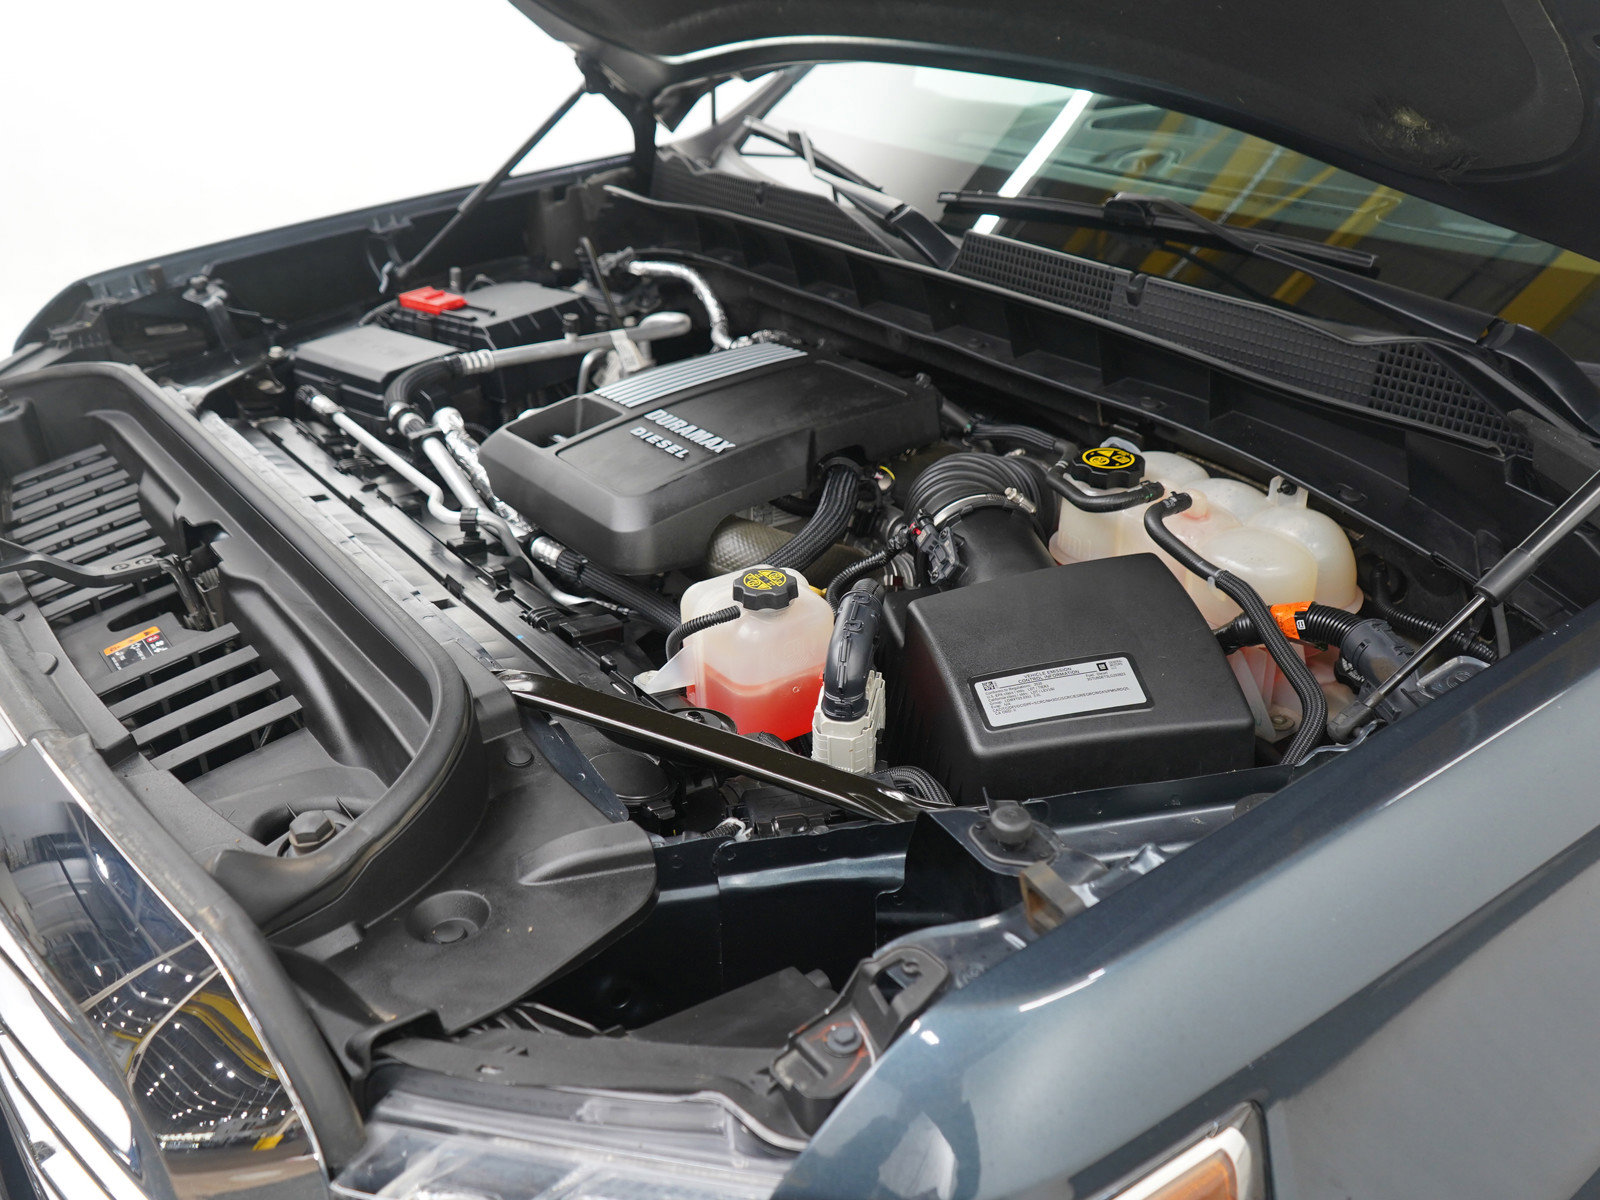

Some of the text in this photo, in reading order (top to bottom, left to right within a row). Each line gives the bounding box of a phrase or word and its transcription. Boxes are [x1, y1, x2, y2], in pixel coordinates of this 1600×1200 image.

[629, 426, 689, 459] DIESEL
[643, 408, 736, 454] DURAMAX
[1018, 676, 1043, 684] CONTROL
[1043, 670, 1081, 680] INFORMATION
[1047, 667, 1072, 675] EMISSION
